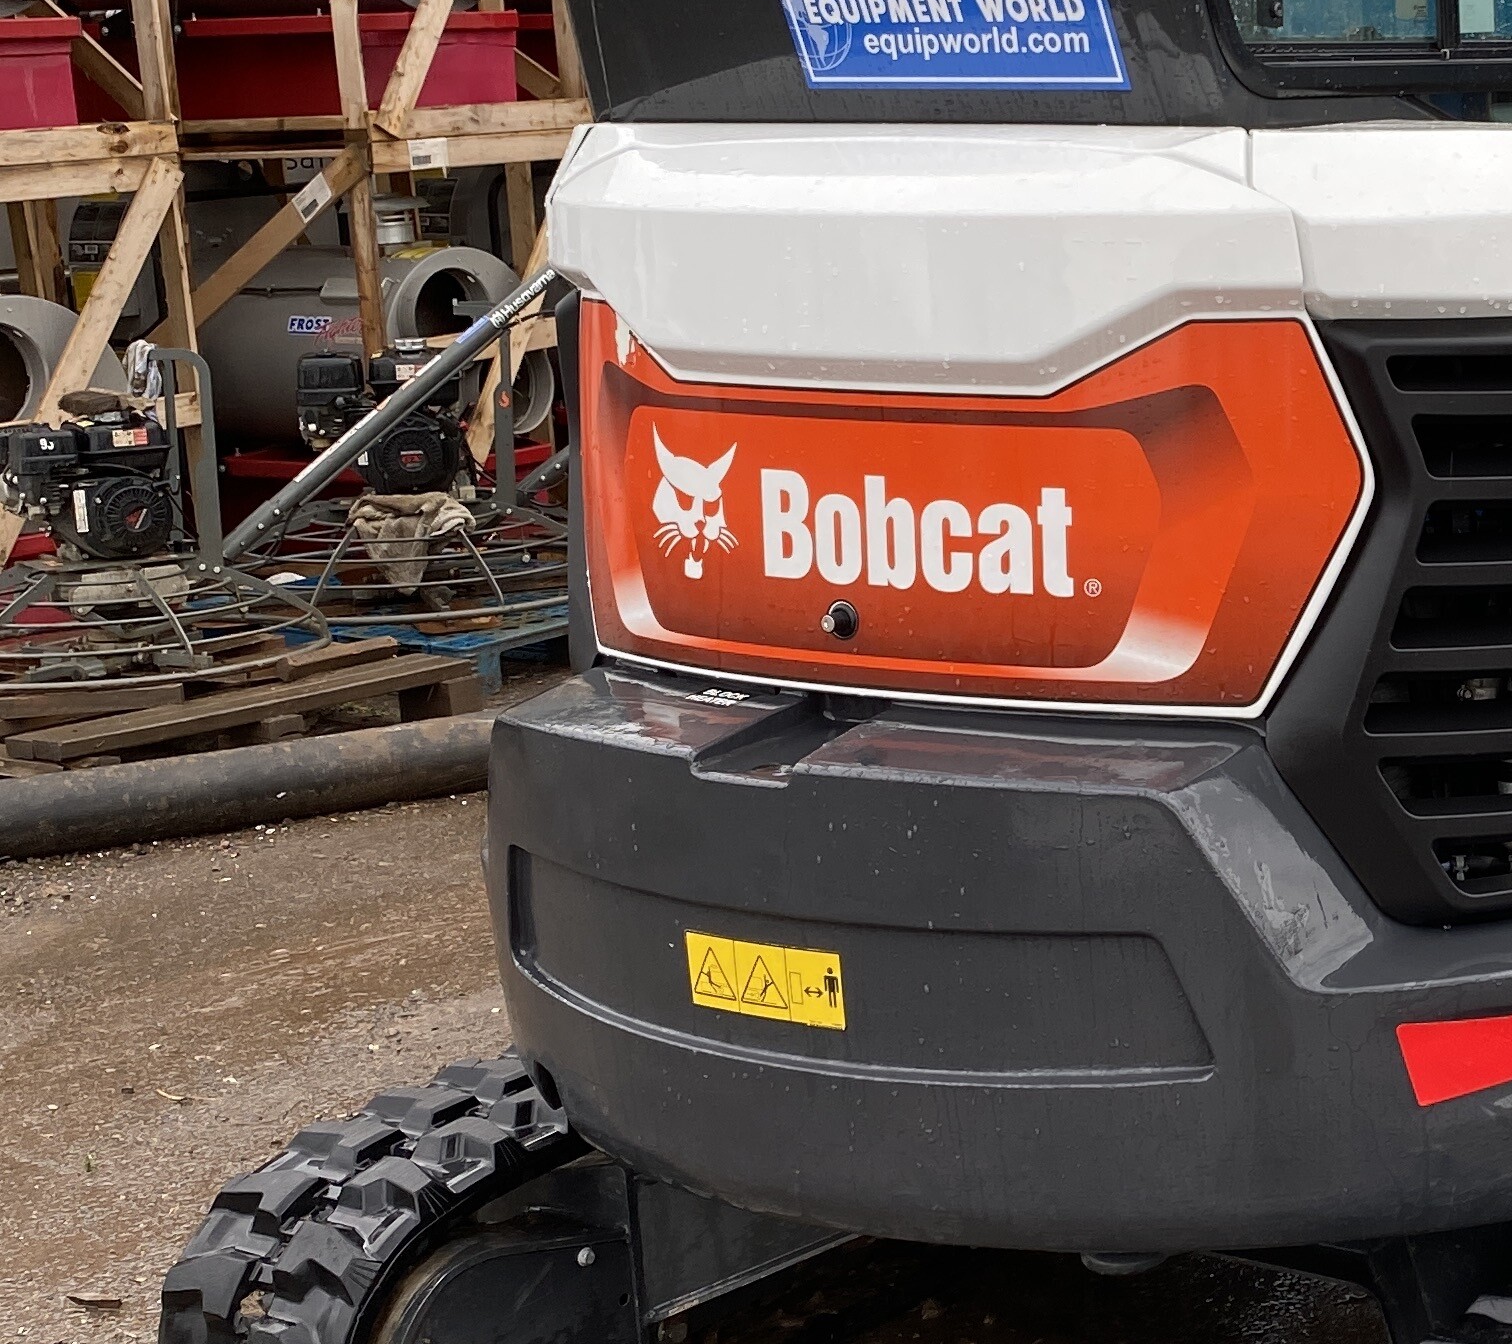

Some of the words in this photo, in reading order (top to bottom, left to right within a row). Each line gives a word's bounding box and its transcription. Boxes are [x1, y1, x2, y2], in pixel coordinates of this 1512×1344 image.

[863, 26, 1090, 61] equipworld.com
[500, 269, 556, 319] Husqvarna
[288, 317, 330, 331] FROST
[760, 468, 1075, 597] Bobcat
